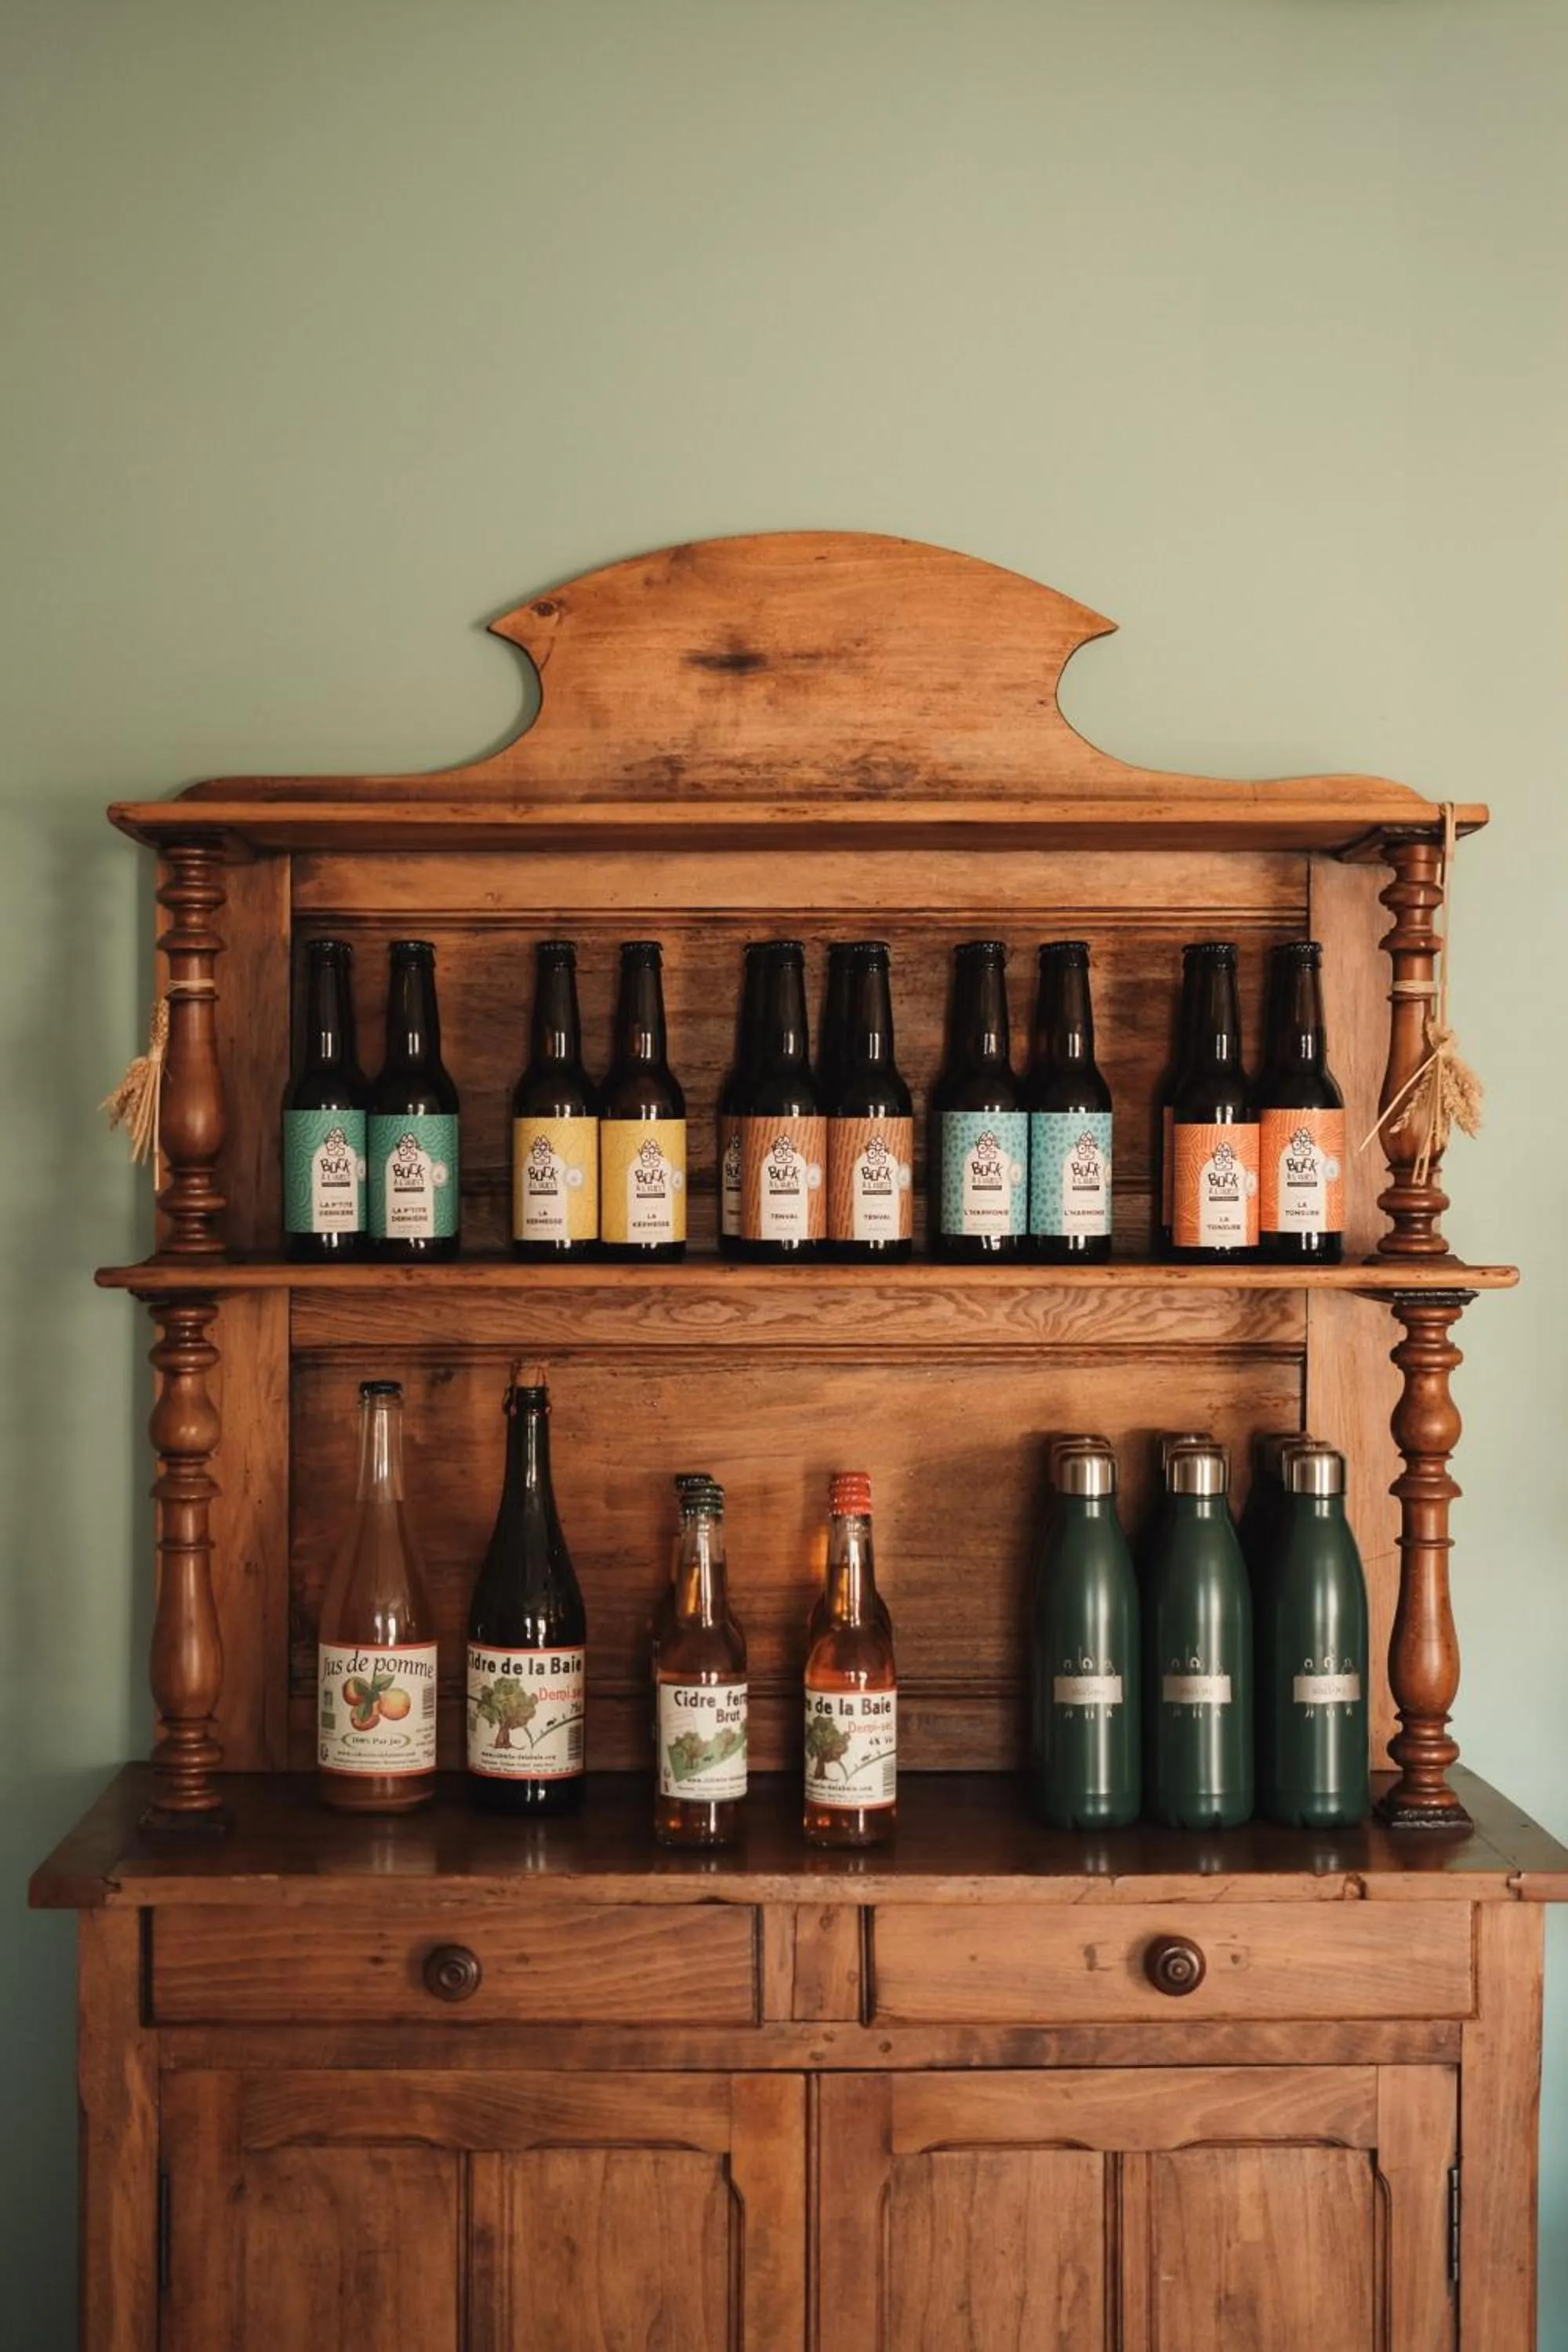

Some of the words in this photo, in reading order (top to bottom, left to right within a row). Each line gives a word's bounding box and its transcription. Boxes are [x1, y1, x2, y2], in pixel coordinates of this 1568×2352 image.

[320, 1159, 350, 1174] BOCK
[393, 1163, 426, 1178] BOCK
[528, 1166, 559, 1181] BOCK
[768, 1166, 800, 1182] BOCK
[861, 1166, 891, 1181] BOCK
[971, 1161, 1003, 1177] BOCK
[1071, 1161, 1101, 1177] BOCK
[1286, 1158, 1318, 1174] BOCK
[634, 1169, 667, 1185] BOCK
[1207, 1172, 1239, 1188] BOCK
[346, 1649, 369, 1672] de
[372, 1656, 434, 1683] pomme
[501, 1657, 524, 1675] de
[528, 1657, 546, 1675] la
[550, 1655, 582, 1675] Baie
[674, 1690, 716, 1708] Cidre
[815, 1696, 833, 1715] de
[840, 1697, 854, 1715] la
[862, 1696, 891, 1715] Baie
[716, 1708, 741, 1723] Brut
